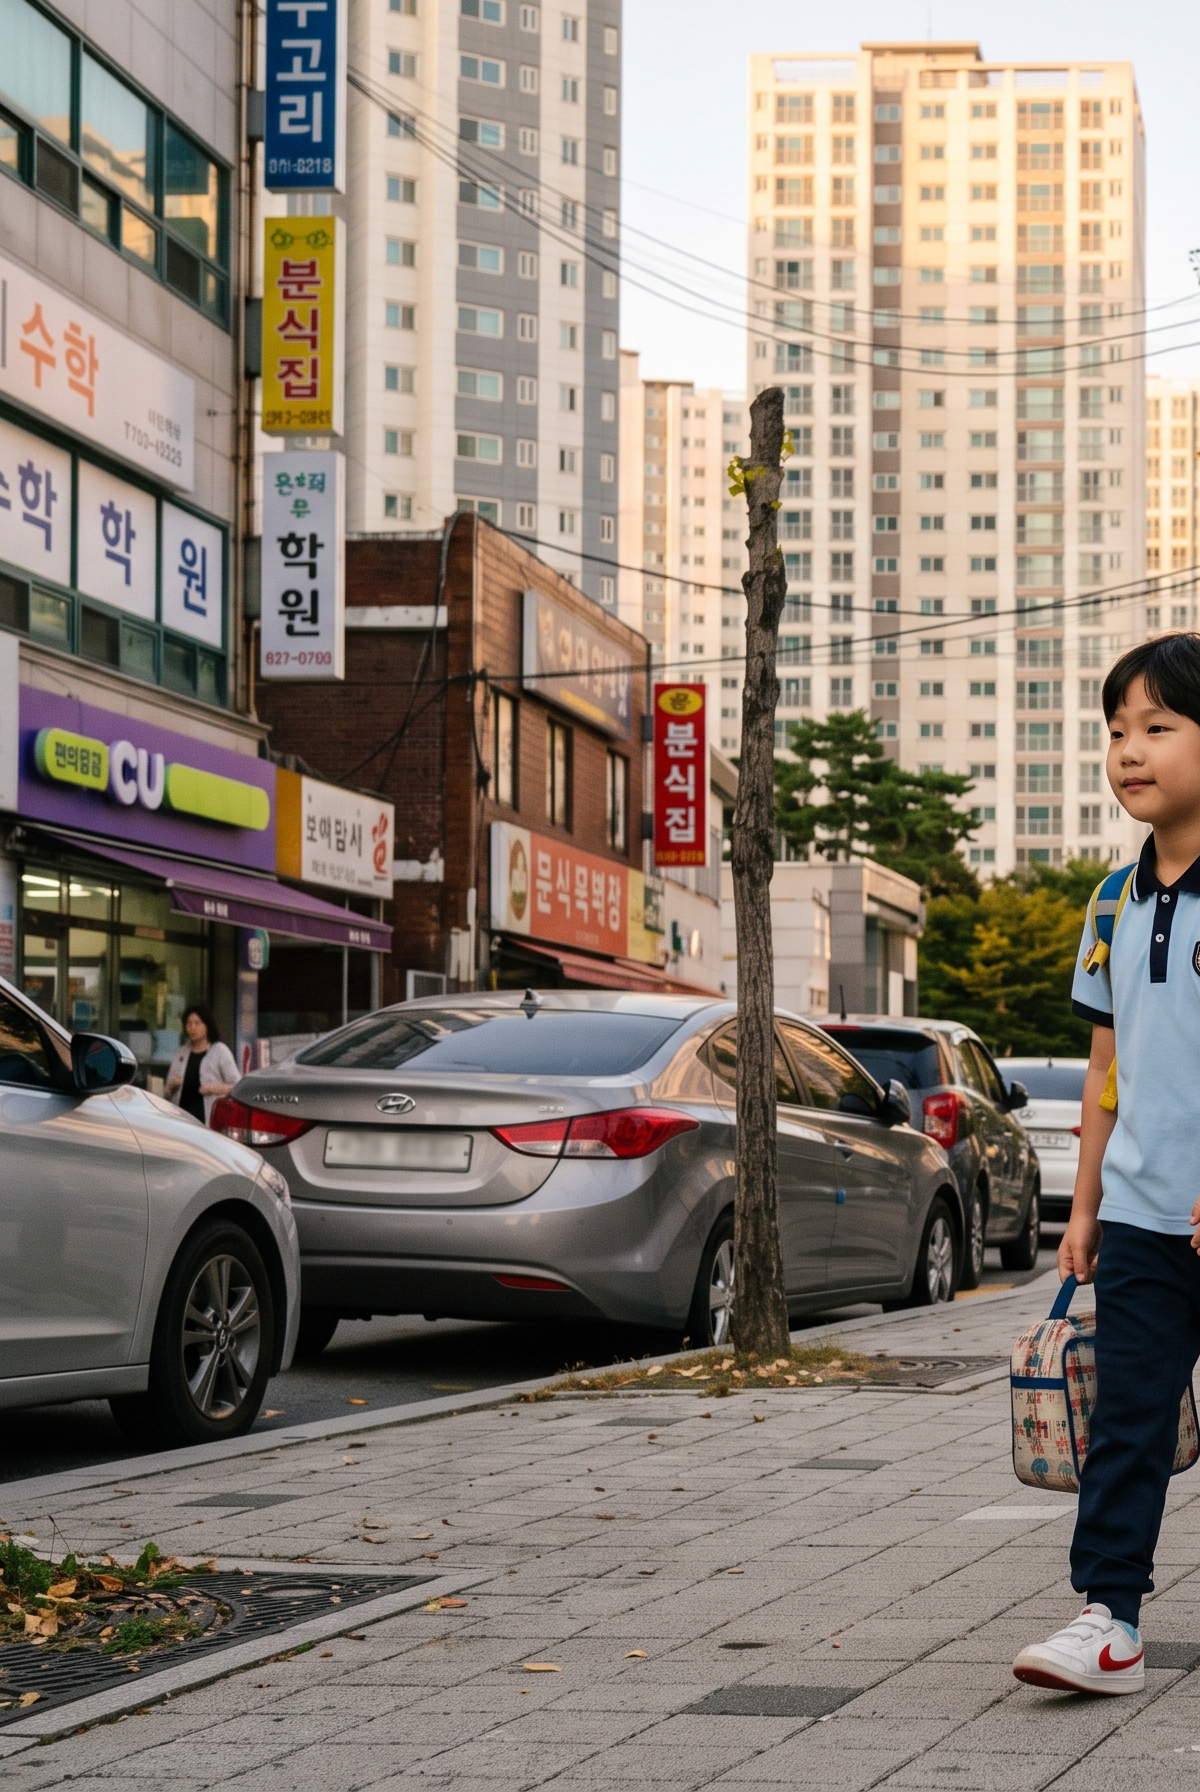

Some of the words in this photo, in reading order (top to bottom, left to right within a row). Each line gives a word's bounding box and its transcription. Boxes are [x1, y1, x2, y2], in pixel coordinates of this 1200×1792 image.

[276, 258, 321, 401] 분식집
[277, 531, 324, 637] 학원
[111, 739, 165, 811] CU
[663, 721, 698, 843] 분식집
